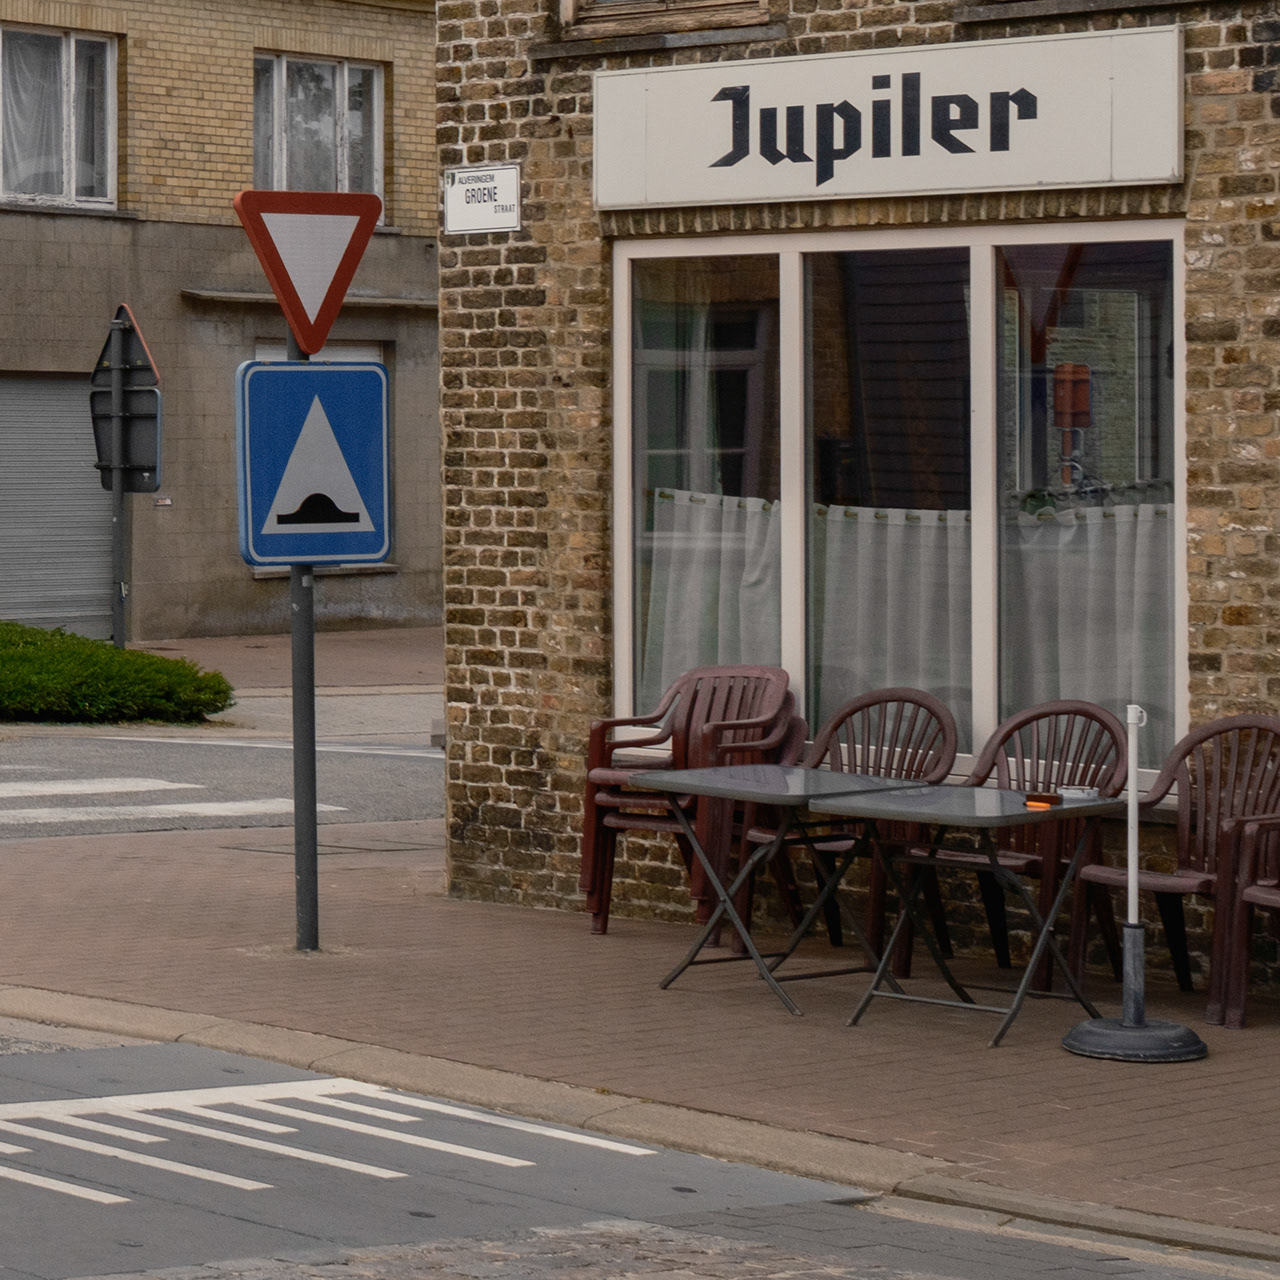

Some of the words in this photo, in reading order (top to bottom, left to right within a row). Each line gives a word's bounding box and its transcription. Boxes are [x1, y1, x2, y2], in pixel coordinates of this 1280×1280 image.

[708, 72, 1038, 187] Jupiler
[458, 174, 495, 185] ALVERINGEM
[465, 186, 498, 204] GROENE
[494, 204, 516, 213] STRAAT
